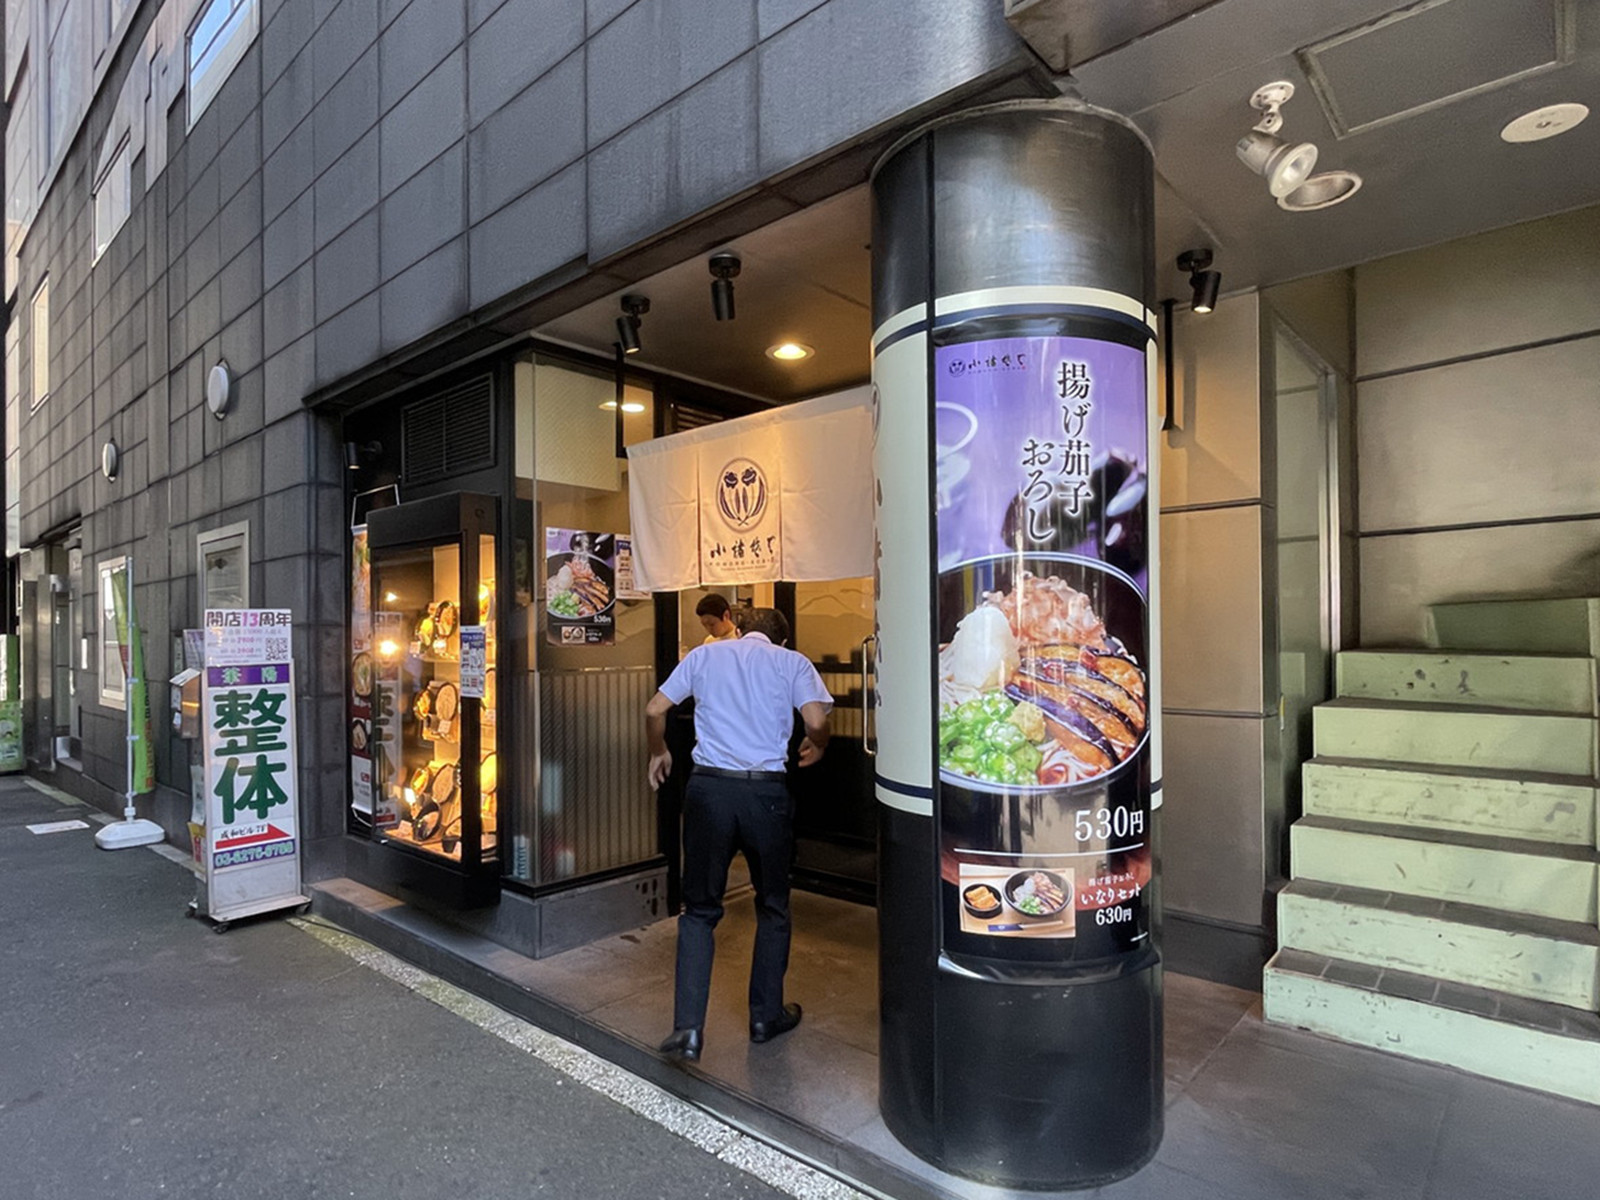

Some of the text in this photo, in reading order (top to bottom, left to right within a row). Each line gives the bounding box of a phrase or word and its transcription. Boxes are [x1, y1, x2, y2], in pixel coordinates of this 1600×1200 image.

[1058, 361, 1093, 516] 揚げ茄子
[1022, 438, 1055, 541] おろし
[213, 688, 288, 824] 整体
[1075, 805, 1144, 841] 530円
[1080, 882, 1141, 905] いなりセット
[1095, 905, 1132, 926] 630円
